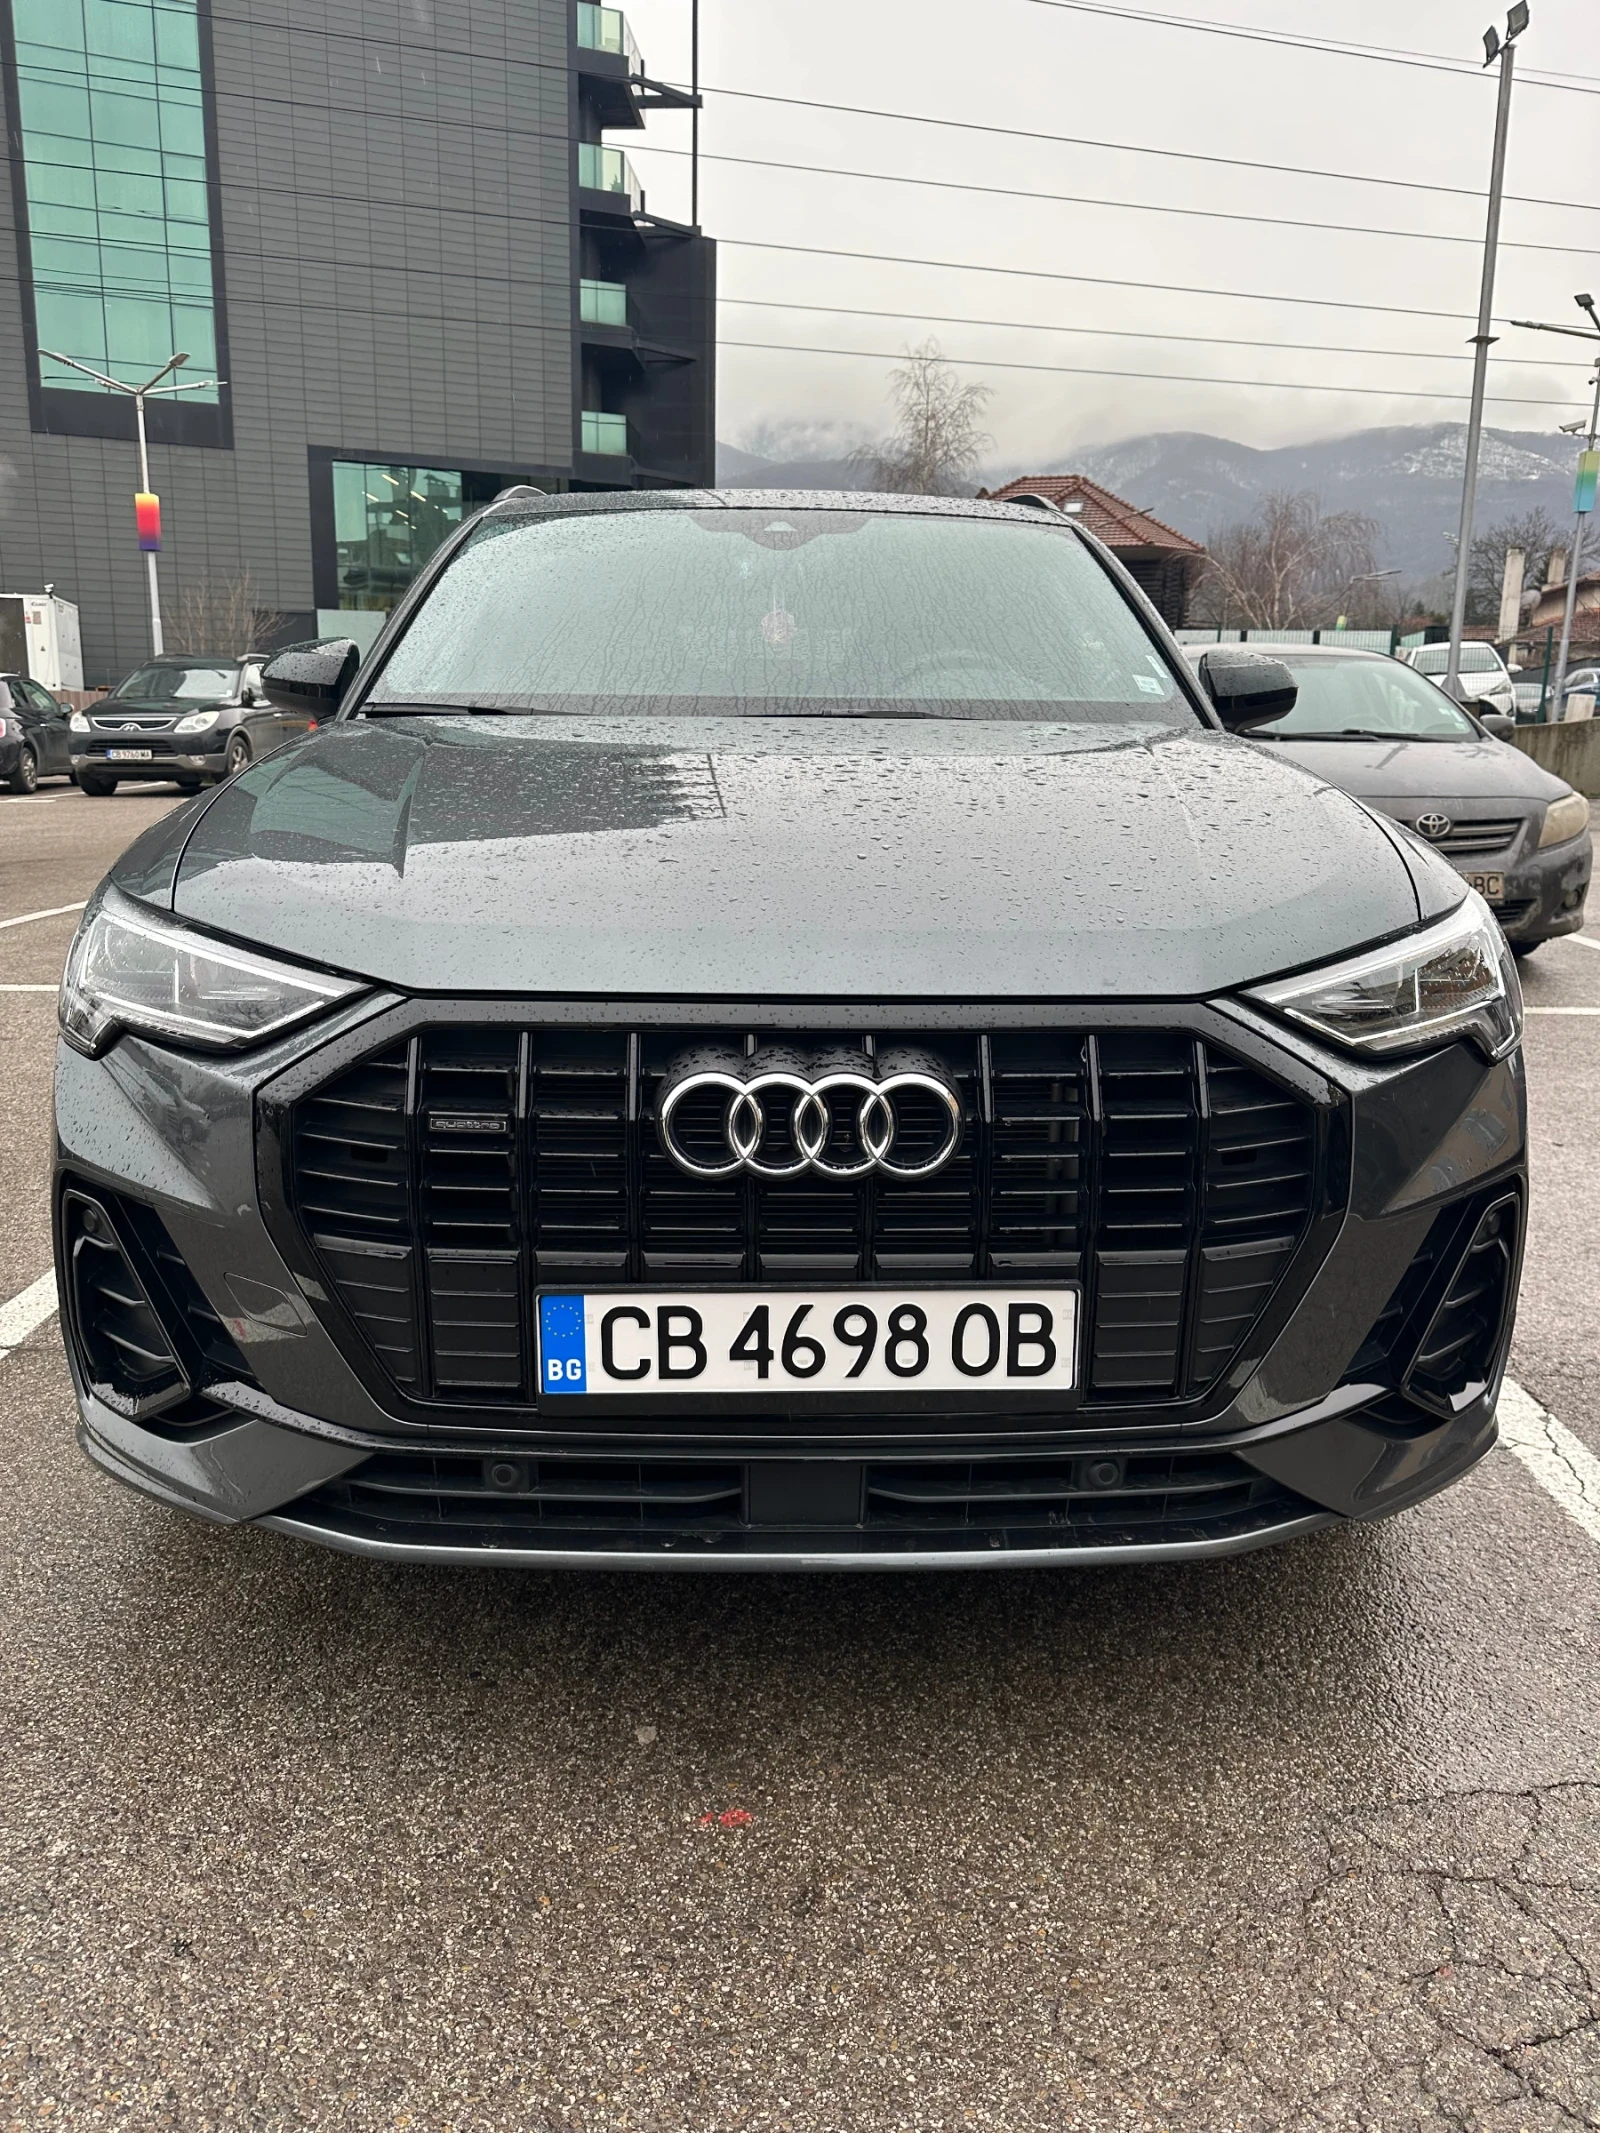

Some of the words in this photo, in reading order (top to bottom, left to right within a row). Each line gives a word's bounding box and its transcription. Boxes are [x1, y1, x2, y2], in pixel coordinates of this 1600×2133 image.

[1474, 876, 1499, 895] BC
[435, 1121, 500, 1129] quattro
[600, 1306, 708, 1380] CB
[729, 1304, 930, 1379] 4698
[951, 1302, 1057, 1377] OB
[548, 1358, 582, 1381] BG
